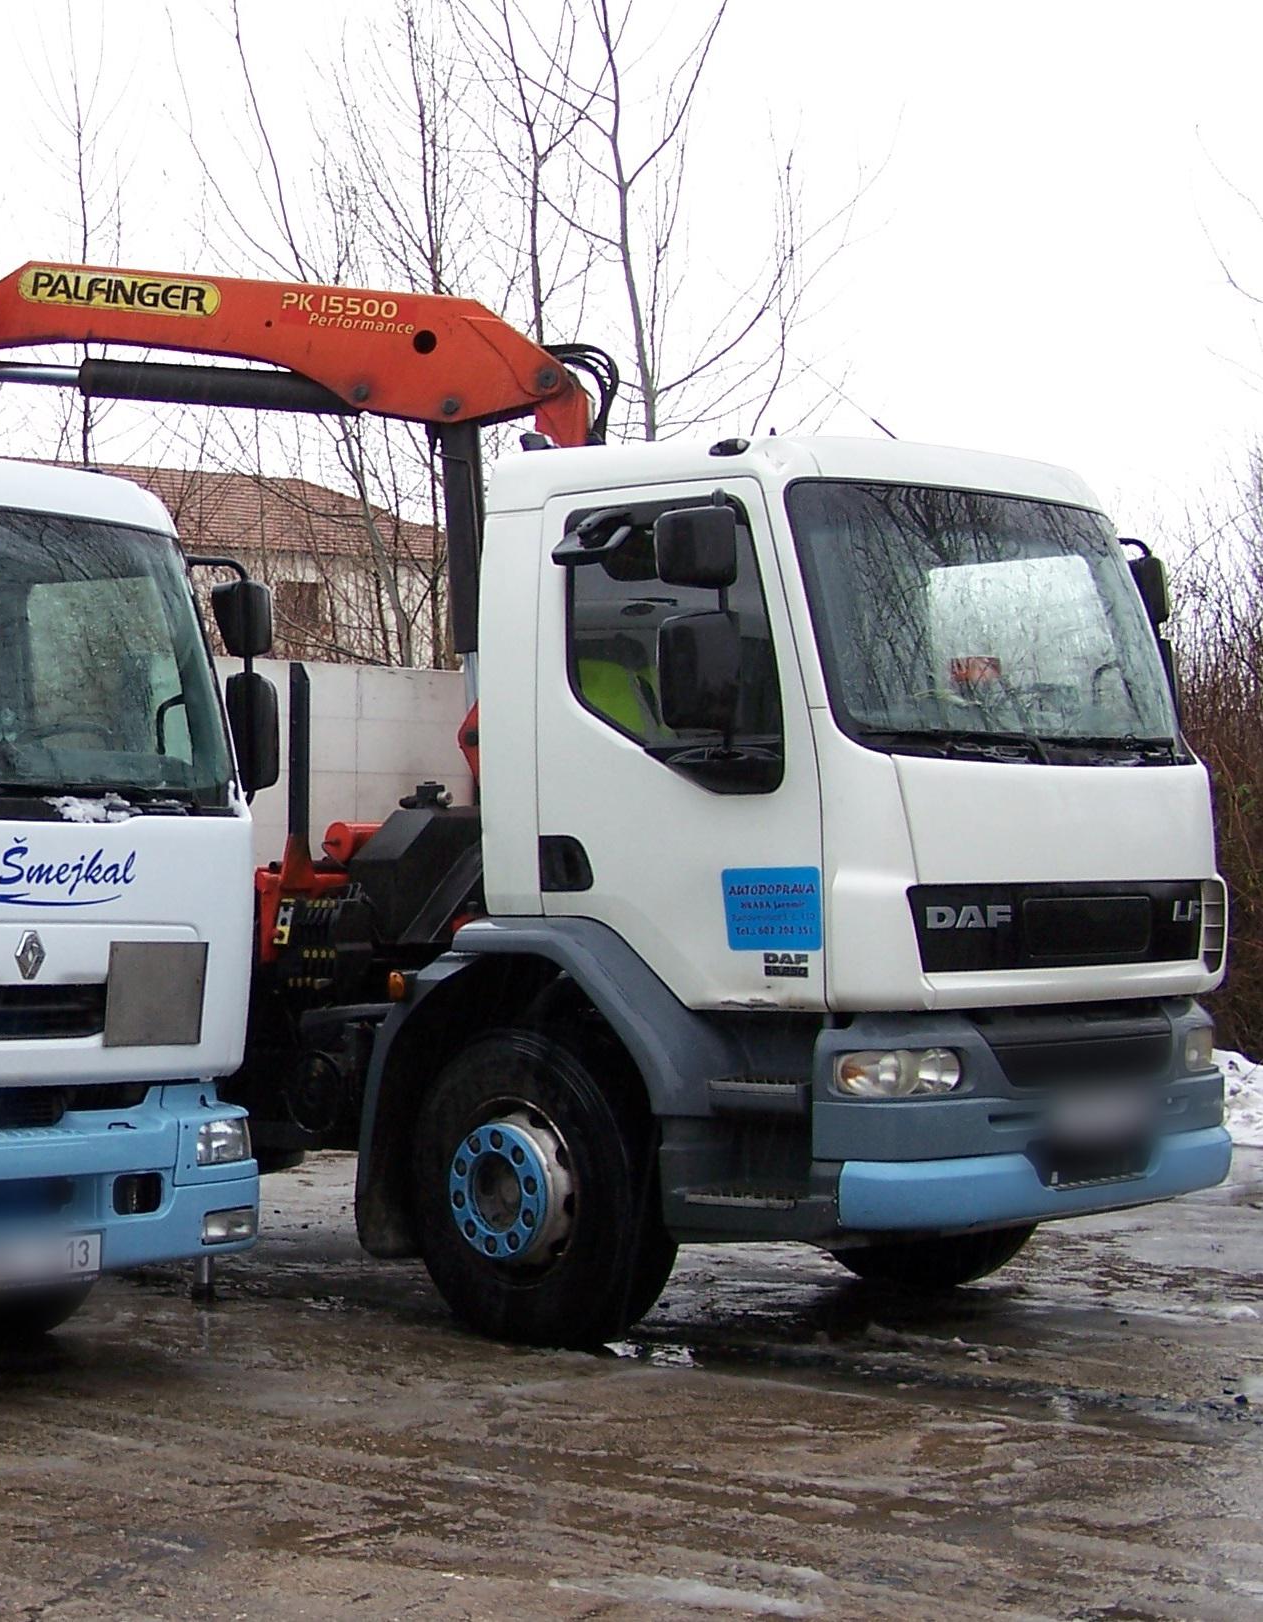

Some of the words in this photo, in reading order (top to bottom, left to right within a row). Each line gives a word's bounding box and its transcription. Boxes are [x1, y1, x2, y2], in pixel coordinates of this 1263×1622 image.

[30, 270, 207, 313] PALFINGER
[282, 292, 313, 312] PK
[321, 296, 398, 318] 15500
[308, 312, 415, 336] Performance
[925, 905, 1012, 930] DAF
[763, 952, 809, 964] DAF
